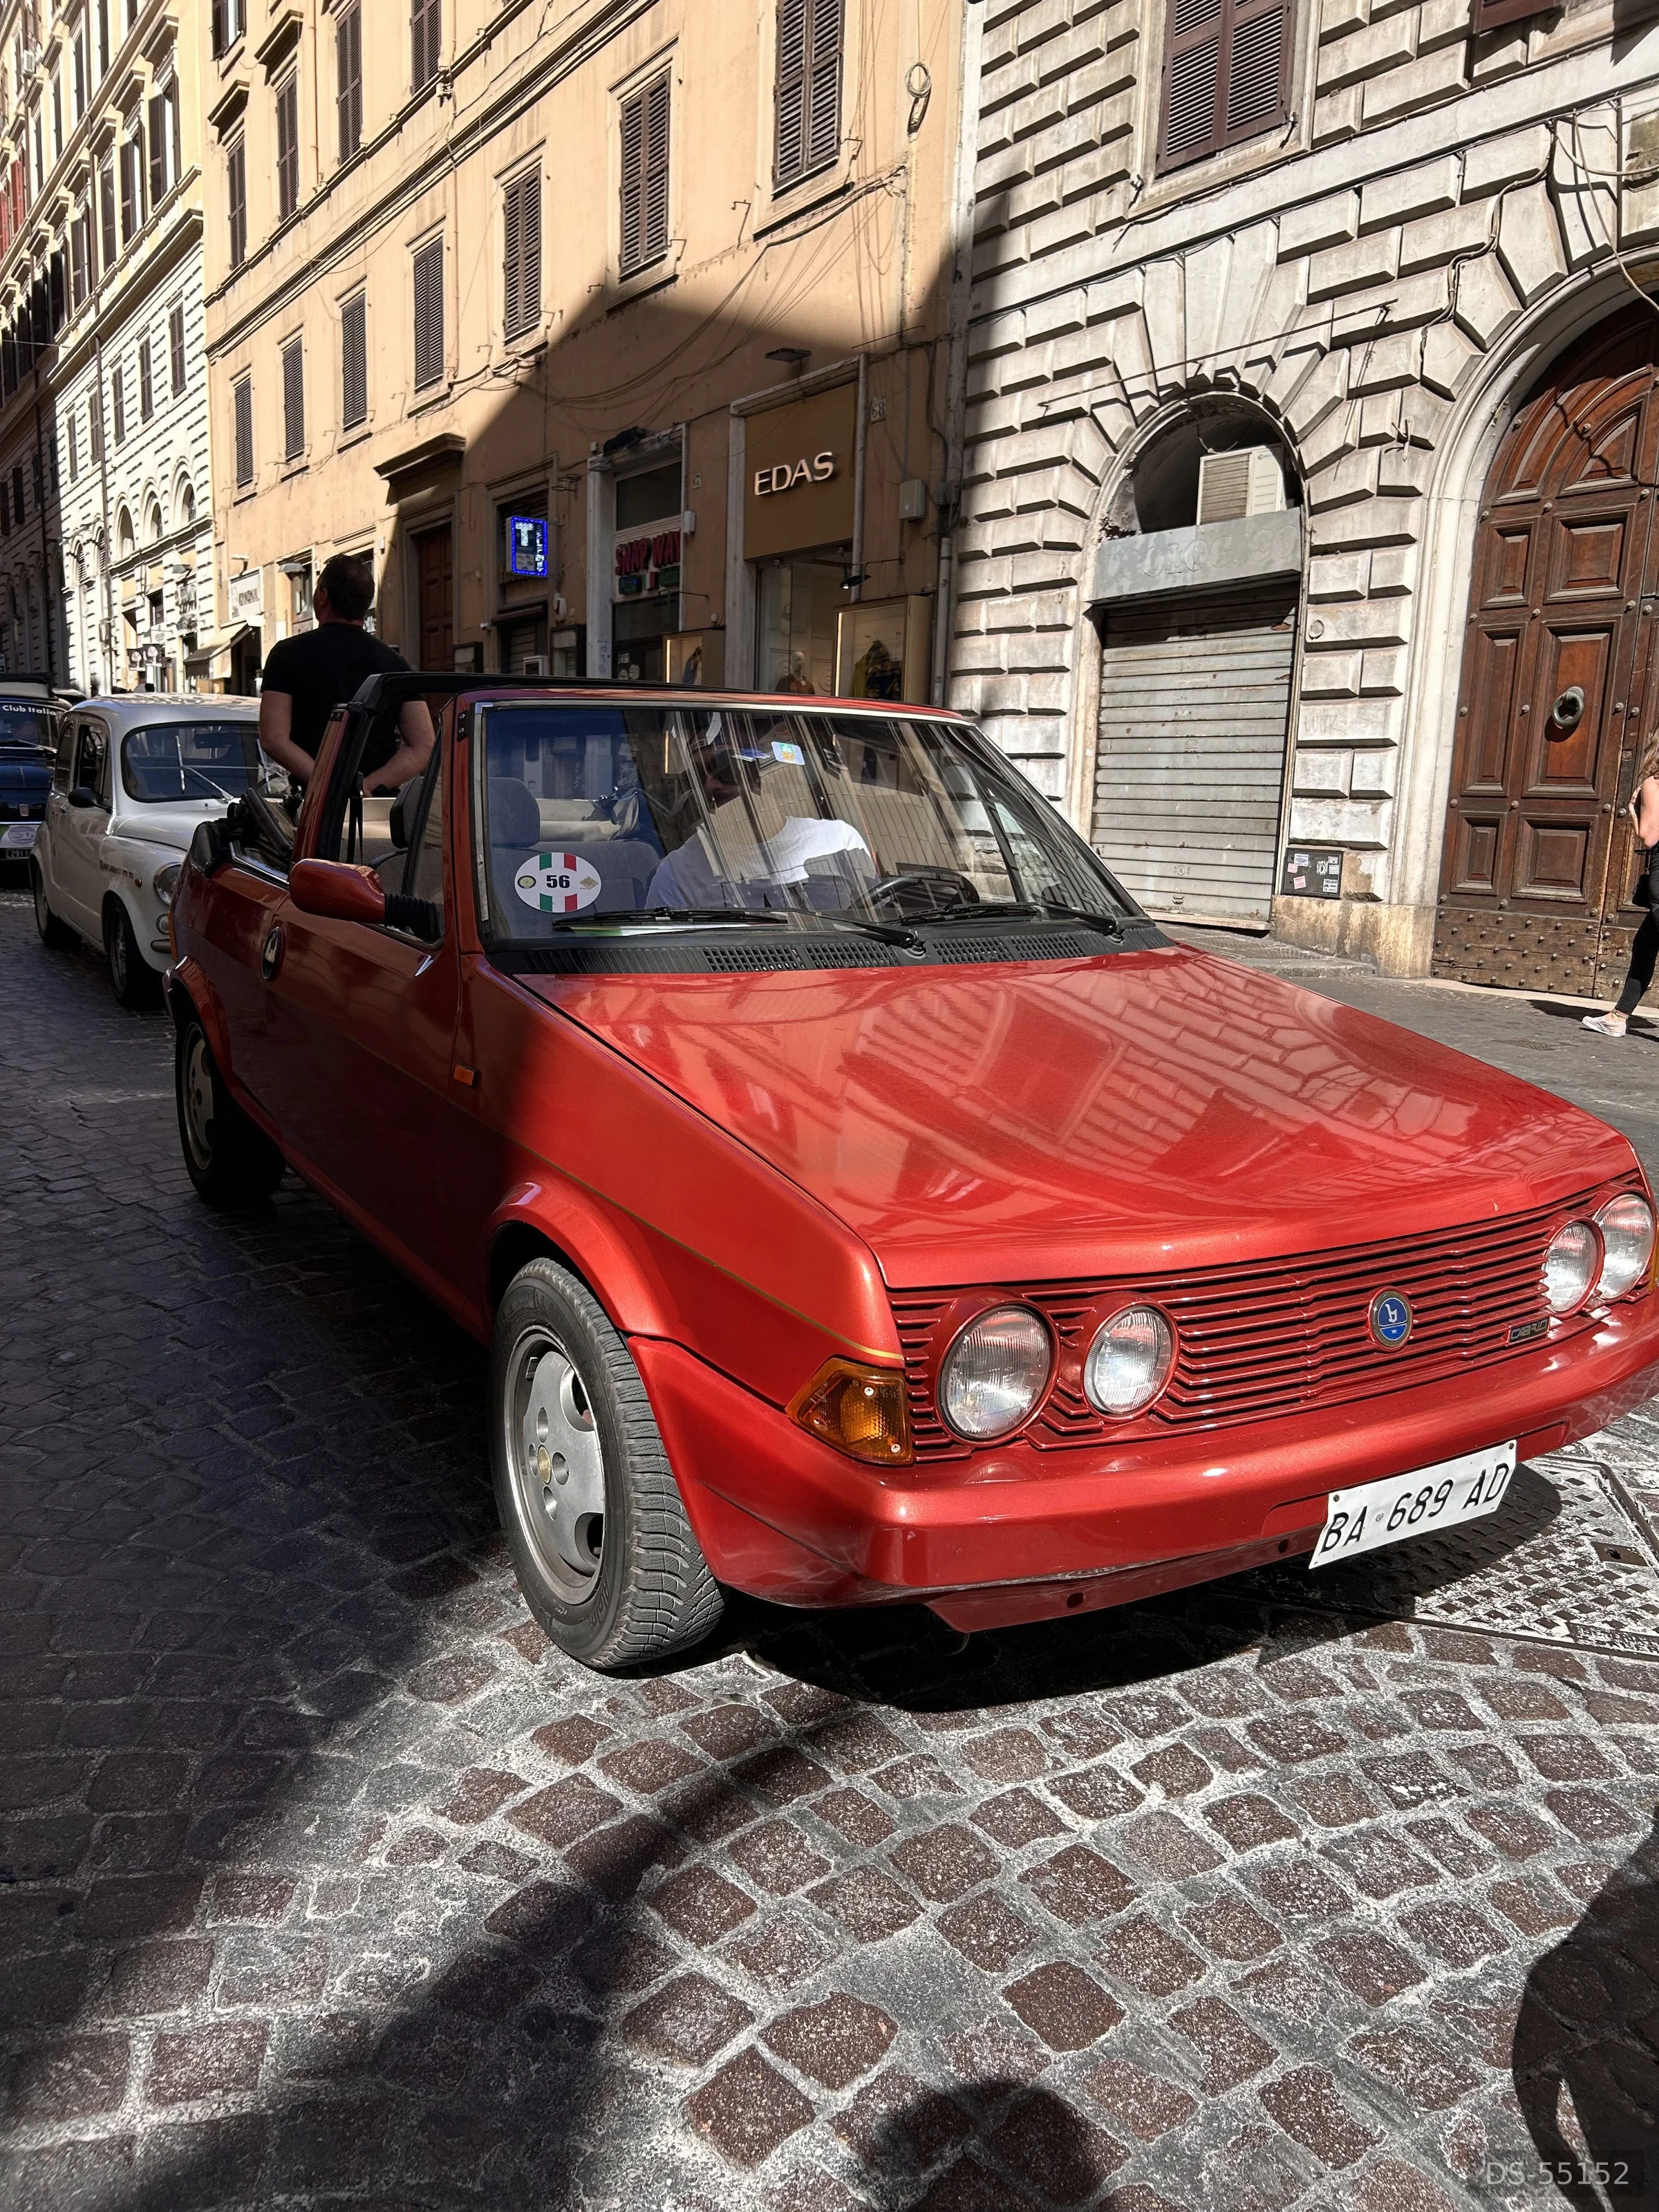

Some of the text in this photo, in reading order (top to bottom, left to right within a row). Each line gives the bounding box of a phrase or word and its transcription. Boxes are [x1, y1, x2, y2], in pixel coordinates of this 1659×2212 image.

[754, 451, 834, 496] EDAS
[515, 522, 534, 546] T
[2, 704, 57, 716] Club Italia
[546, 874, 570, 888] 56
[1319, 1463, 1509, 1554] BA 689 AD
